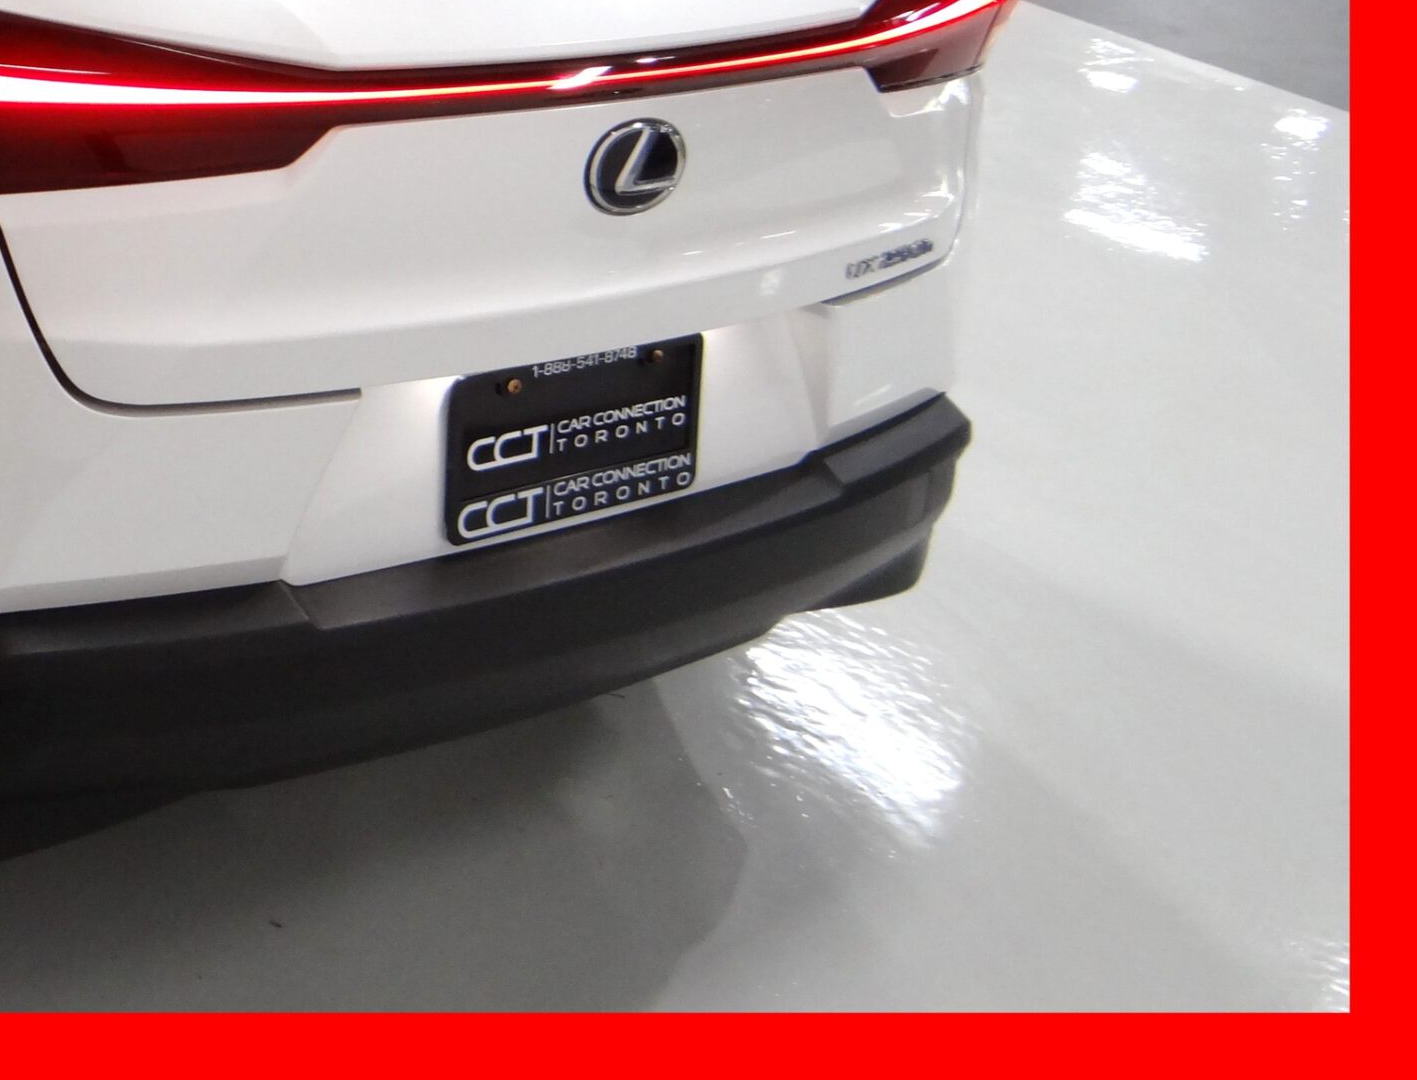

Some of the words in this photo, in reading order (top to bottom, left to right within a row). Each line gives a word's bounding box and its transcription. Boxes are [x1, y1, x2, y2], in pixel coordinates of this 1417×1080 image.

[556, 412, 685, 452] TORONTO
[557, 415, 591, 434] CAR
[592, 395, 686, 426] CONNECTION
[467, 424, 548, 471] CCT
[552, 471, 691, 516] TORONTO
[553, 478, 590, 496] CAR
[591, 452, 691, 488] CONNECTION
[457, 486, 544, 539] CCT
